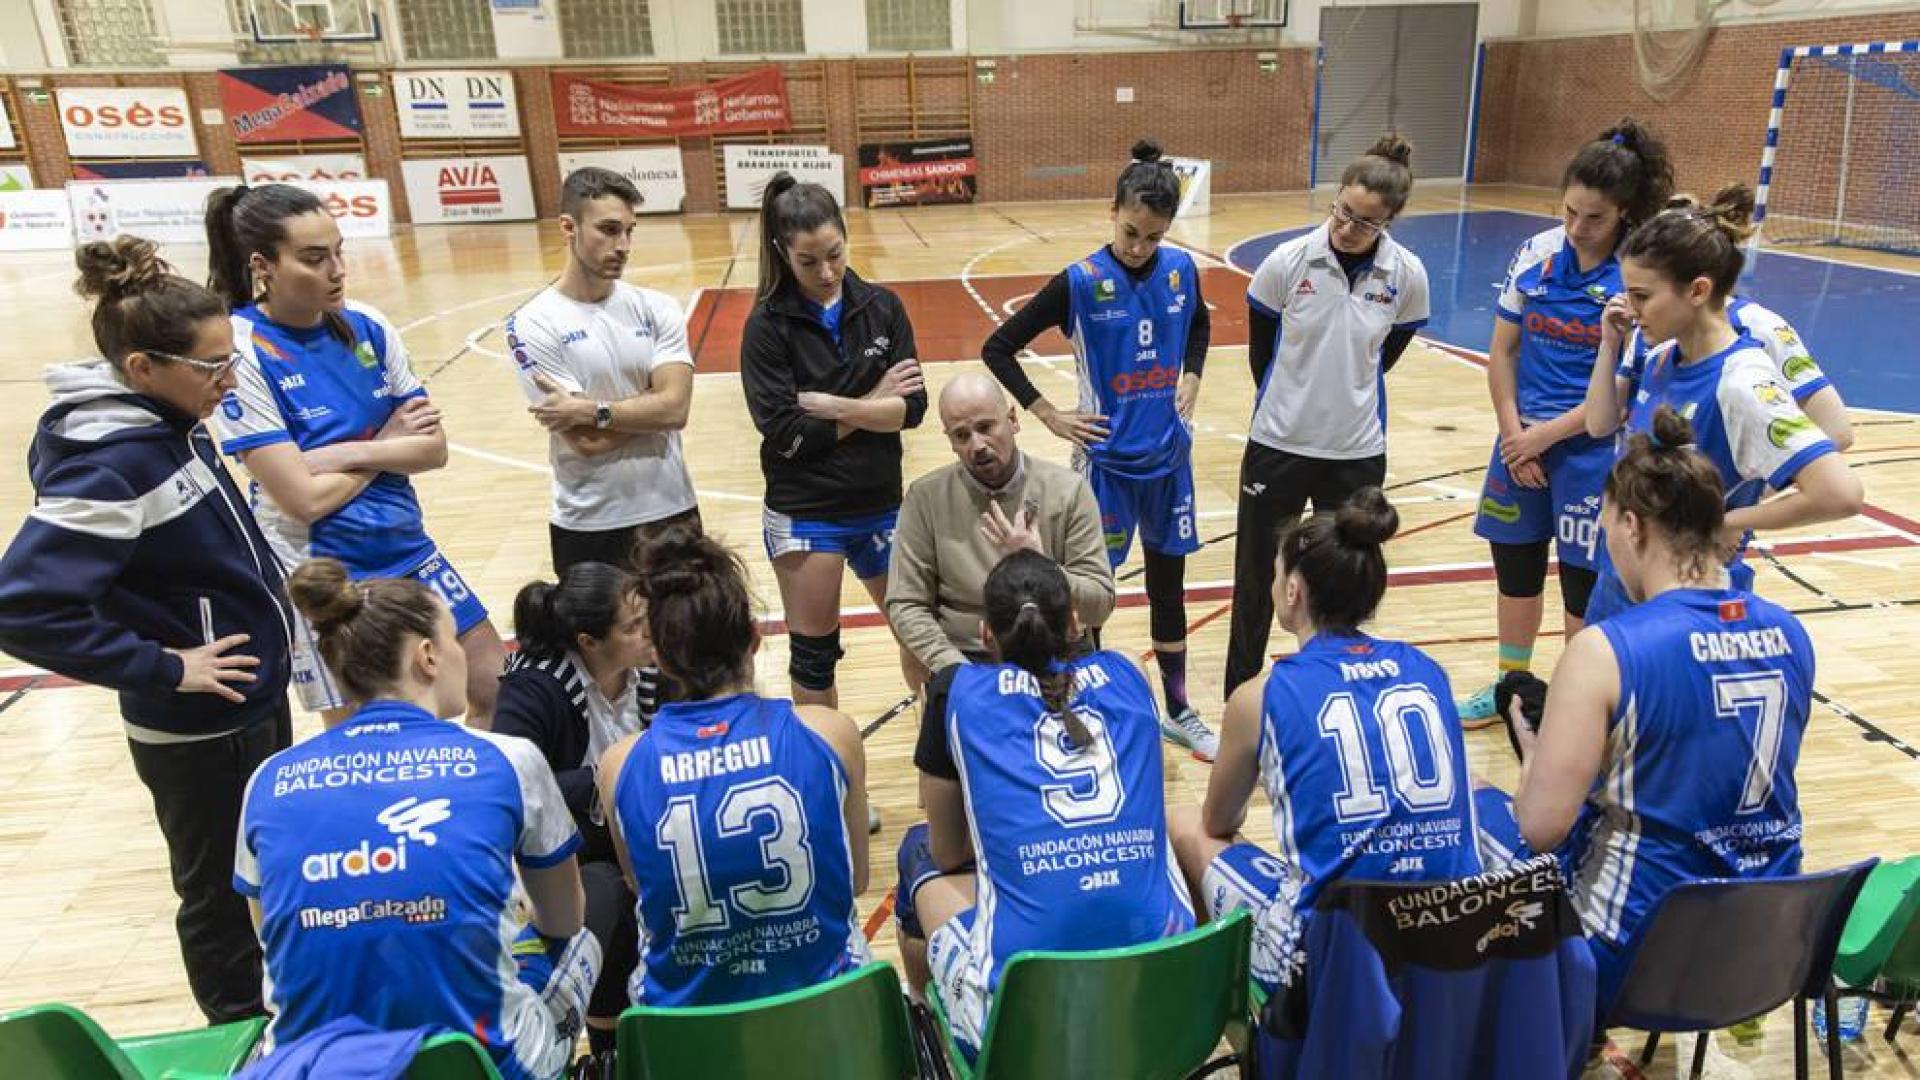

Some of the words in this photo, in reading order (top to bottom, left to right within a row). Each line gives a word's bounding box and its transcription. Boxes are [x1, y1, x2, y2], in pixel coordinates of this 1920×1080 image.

[408, 77, 445, 99] DN
[466, 77, 503, 98] DN
[1138, 319, 1154, 347] 8
[1178, 515, 1192, 540] 8
[1690, 626, 1792, 663] CABRERA
[660, 735, 772, 784] ARREGUI
[1316, 682, 1456, 824] 10
[1712, 670, 1789, 815] 7
[274, 761, 478, 798] BALONCESTO
[277, 750, 381, 780] FUNDACIÓN
[386, 748, 477, 766] NAVARRA
[1034, 705, 1126, 828] 9
[302, 835, 406, 883] ardoi
[655, 775, 816, 938] 13
[1019, 833, 1104, 860] FUNDACIÓN
[1023, 844, 1155, 876] BALONCESTO
[300, 896, 446, 931] MegaCalzado
[1396, 869, 1562, 931] BALONCES
[754, 915, 820, 939] NAVARRA
